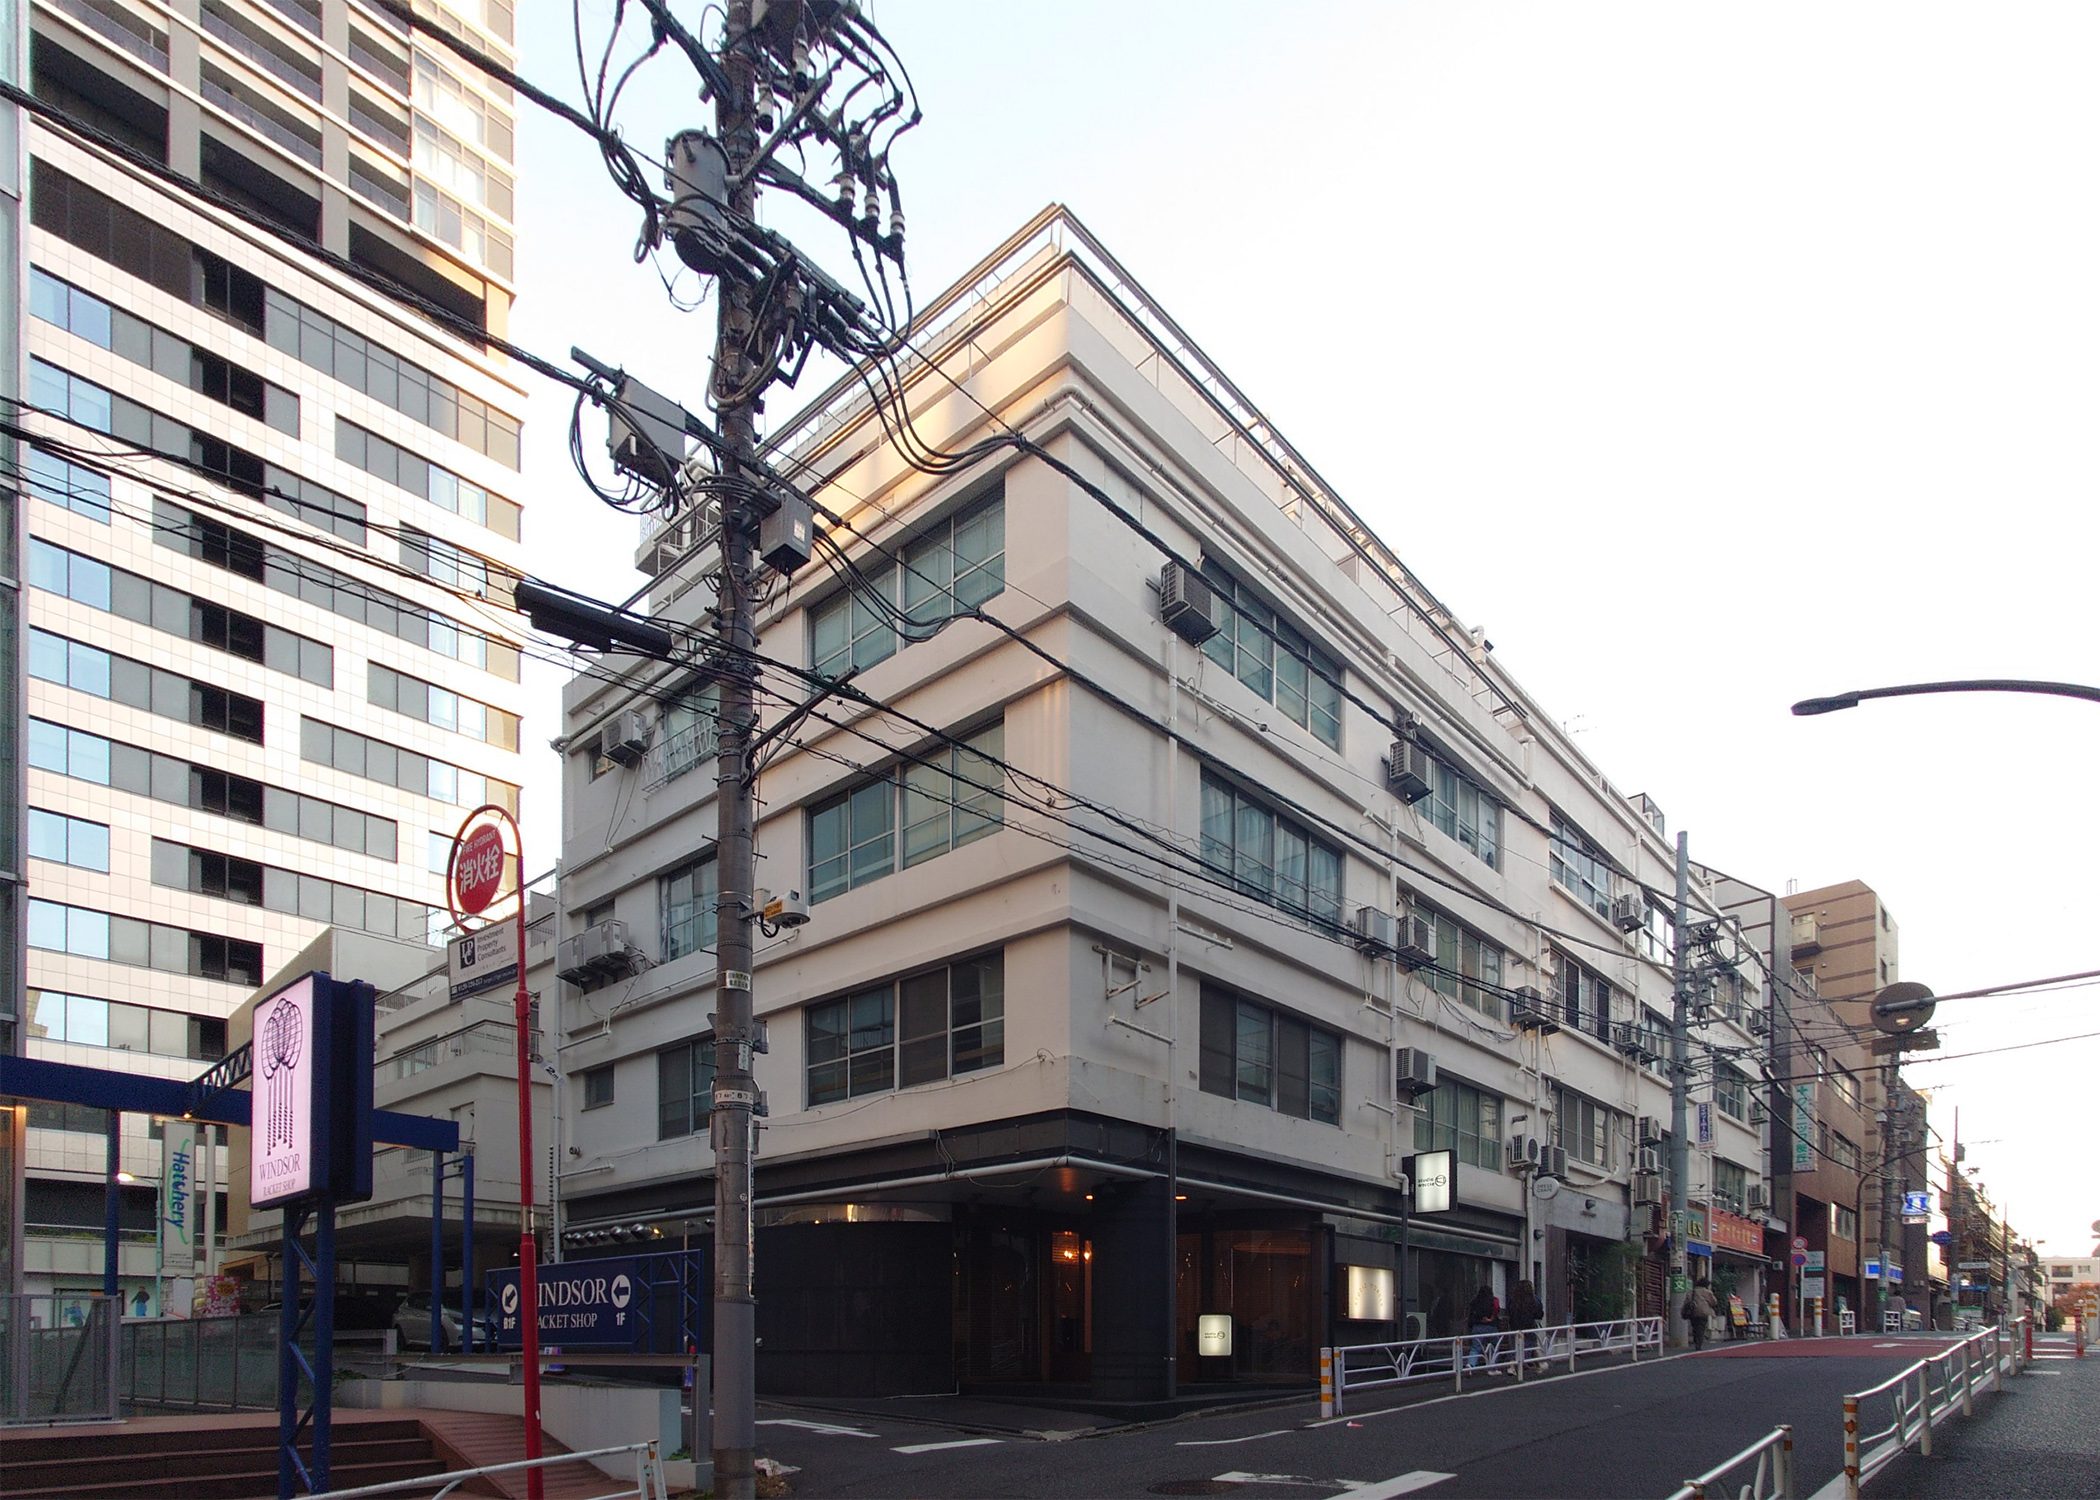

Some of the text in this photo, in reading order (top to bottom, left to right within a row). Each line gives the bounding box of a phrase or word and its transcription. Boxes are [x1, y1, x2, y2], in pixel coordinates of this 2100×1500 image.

[463, 830, 496, 854] FIRE HYDRANT
[459, 844, 501, 896] 消火栓
[477, 927, 504, 943] Investment
[477, 940, 498, 953] Property
[477, 945, 507, 962] Consultants
[259, 1153, 301, 1180] WINDSOR
[165, 1151, 190, 1229] Hatchery
[263, 1178, 296, 1197] RACKET SHOP
[537, 1278, 609, 1308] INDSOR
[503, 1316, 516, 1330] B1F
[537, 1312, 598, 1329] ACKET SHOP
[615, 1312, 626, 1326] 1F
